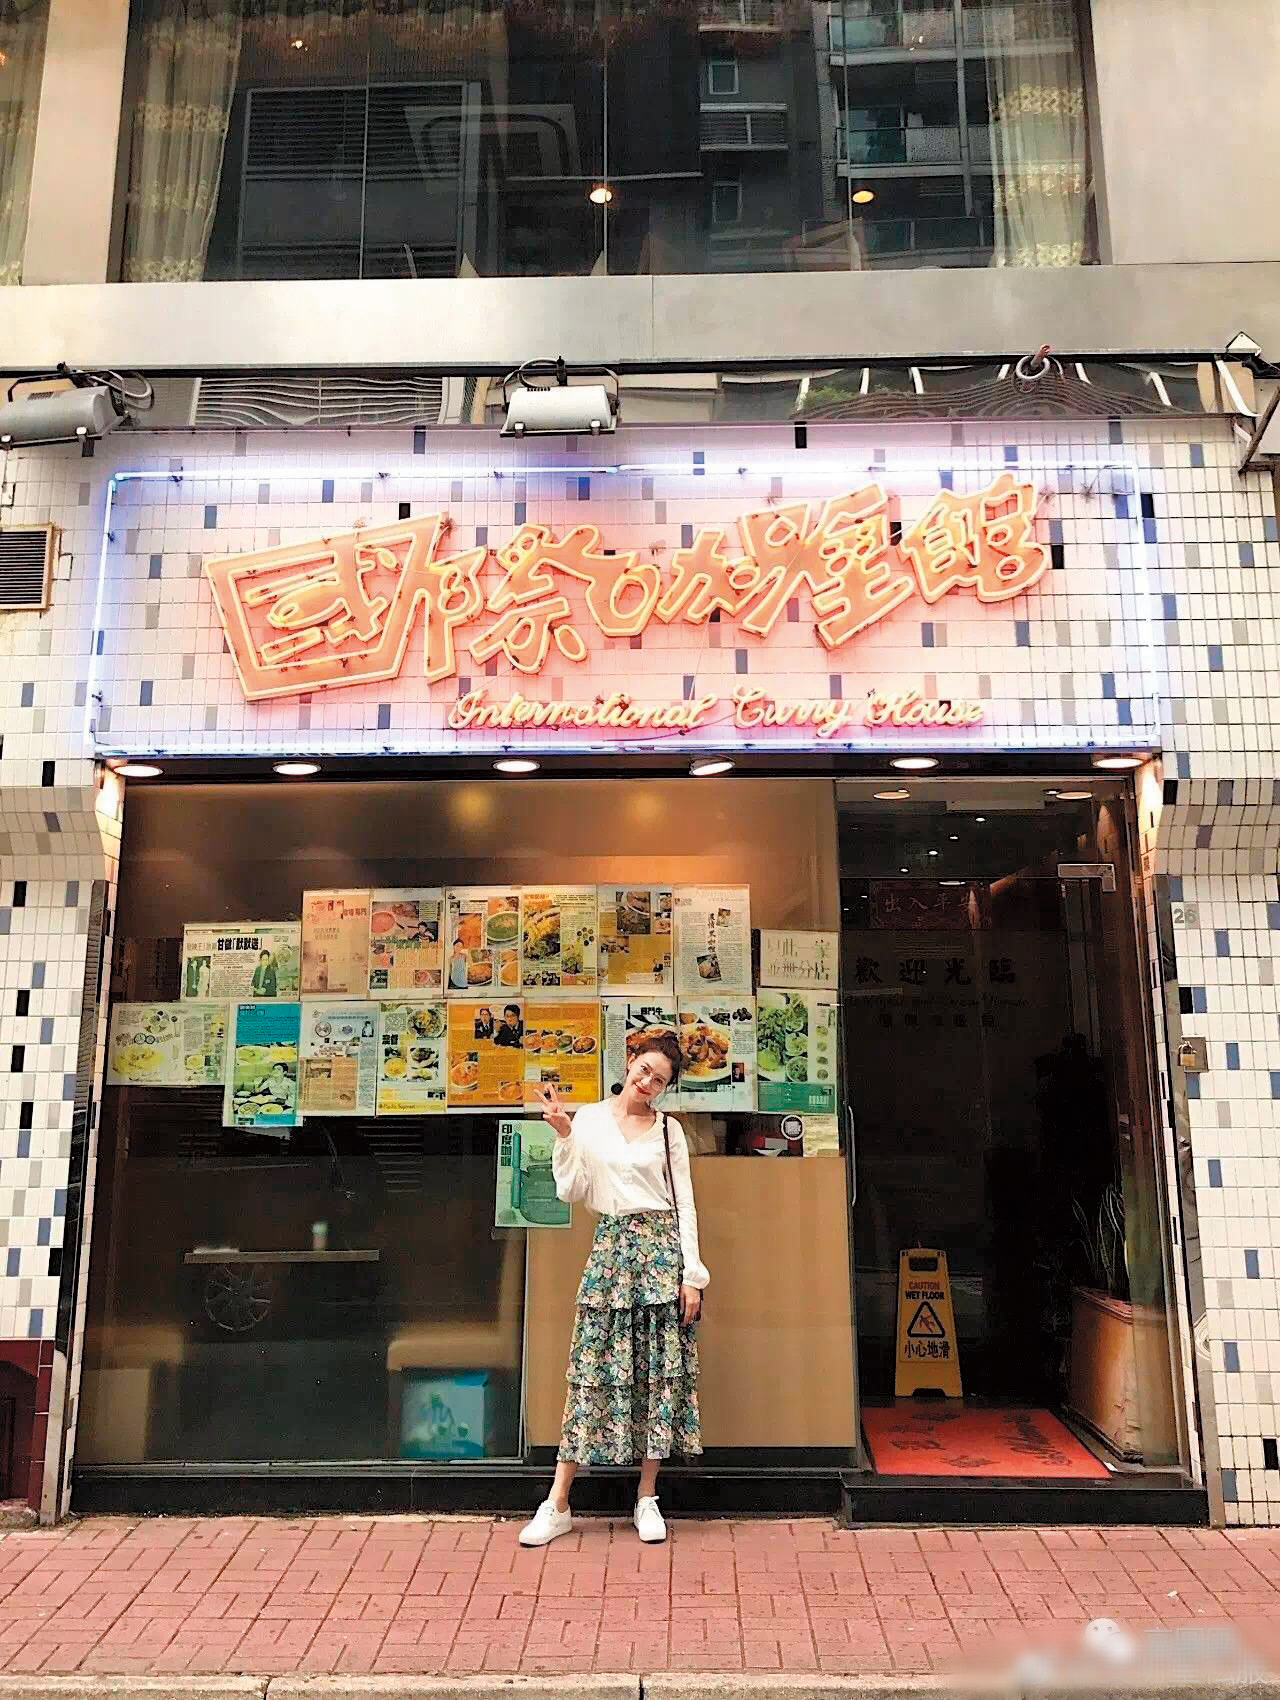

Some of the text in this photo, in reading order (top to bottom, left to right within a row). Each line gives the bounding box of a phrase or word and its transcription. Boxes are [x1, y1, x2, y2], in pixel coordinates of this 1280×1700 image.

[448, 683, 986, 738] International Curry House
[1173, 908, 1198, 924] 26
[855, 955, 1017, 985] 歡迎光臨
[908, 1281, 941, 1290] CAUTION
[905, 1290, 945, 1300] WET FLOOR
[904, 1339, 951, 1359] 小心地滑
